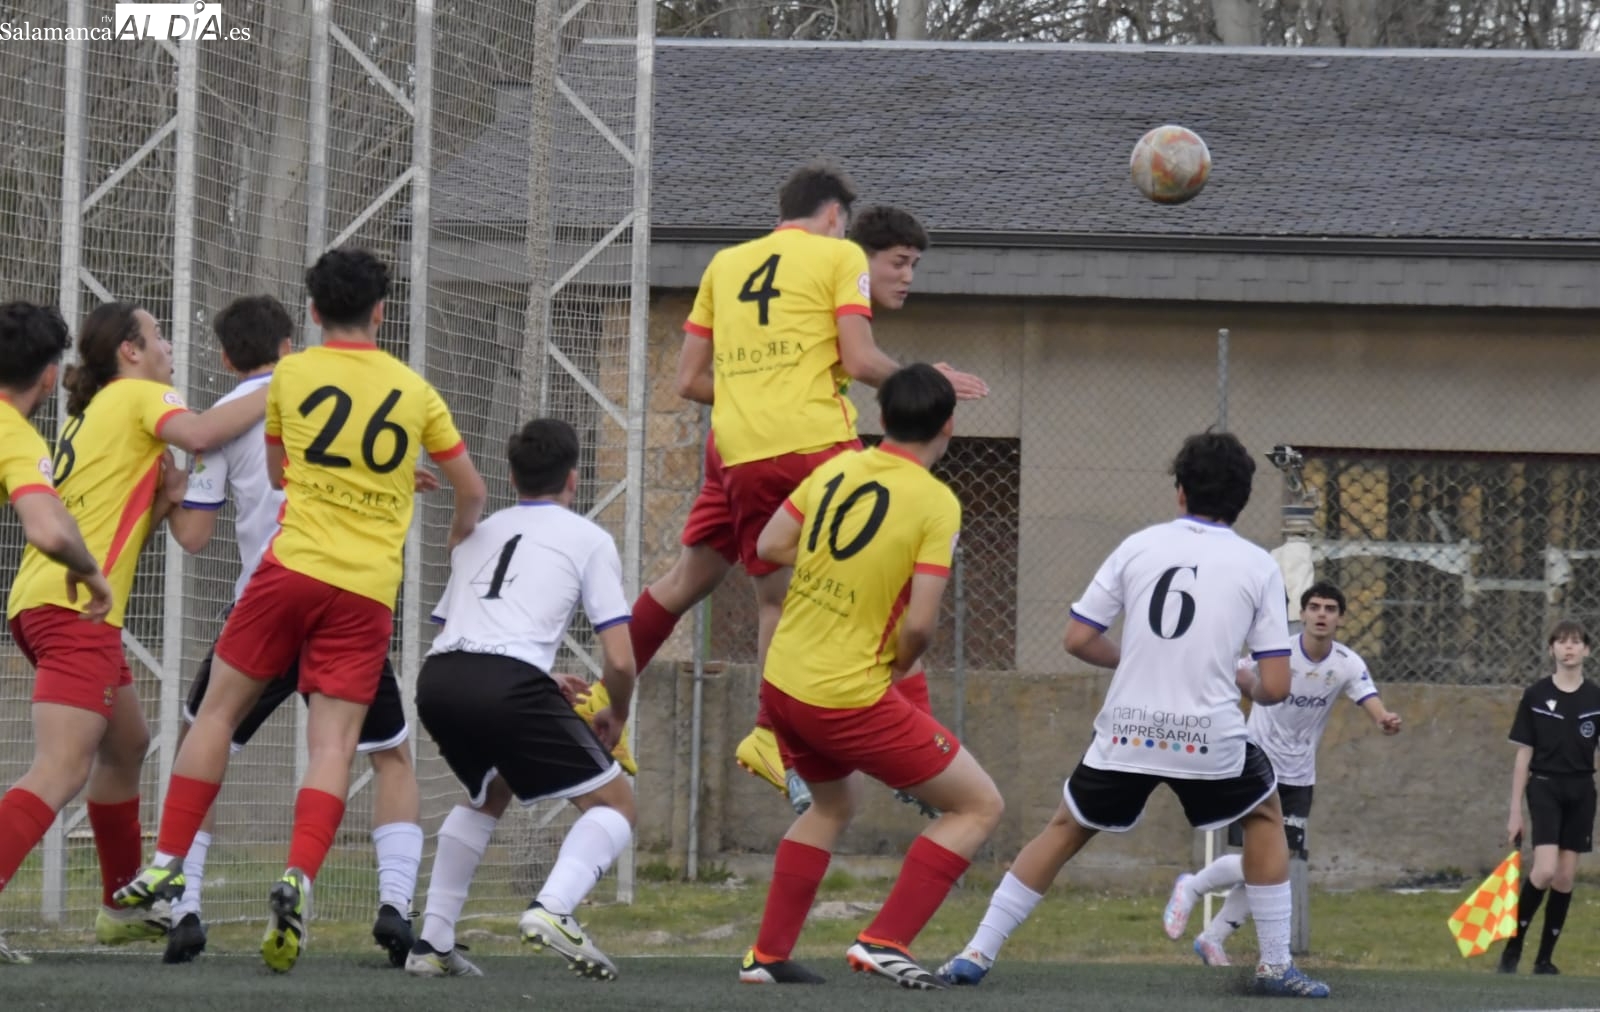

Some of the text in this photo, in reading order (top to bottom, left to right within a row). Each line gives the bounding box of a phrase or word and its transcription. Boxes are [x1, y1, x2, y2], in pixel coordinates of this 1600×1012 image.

[737, 254, 782, 326] 4
[298, 385, 409, 474] 26
[807, 472, 890, 562] 10
[1148, 564, 1198, 640] 6
[1112, 704, 1212, 730] nani grupo
[1112, 723, 1210, 745] EMPRESARIAL
